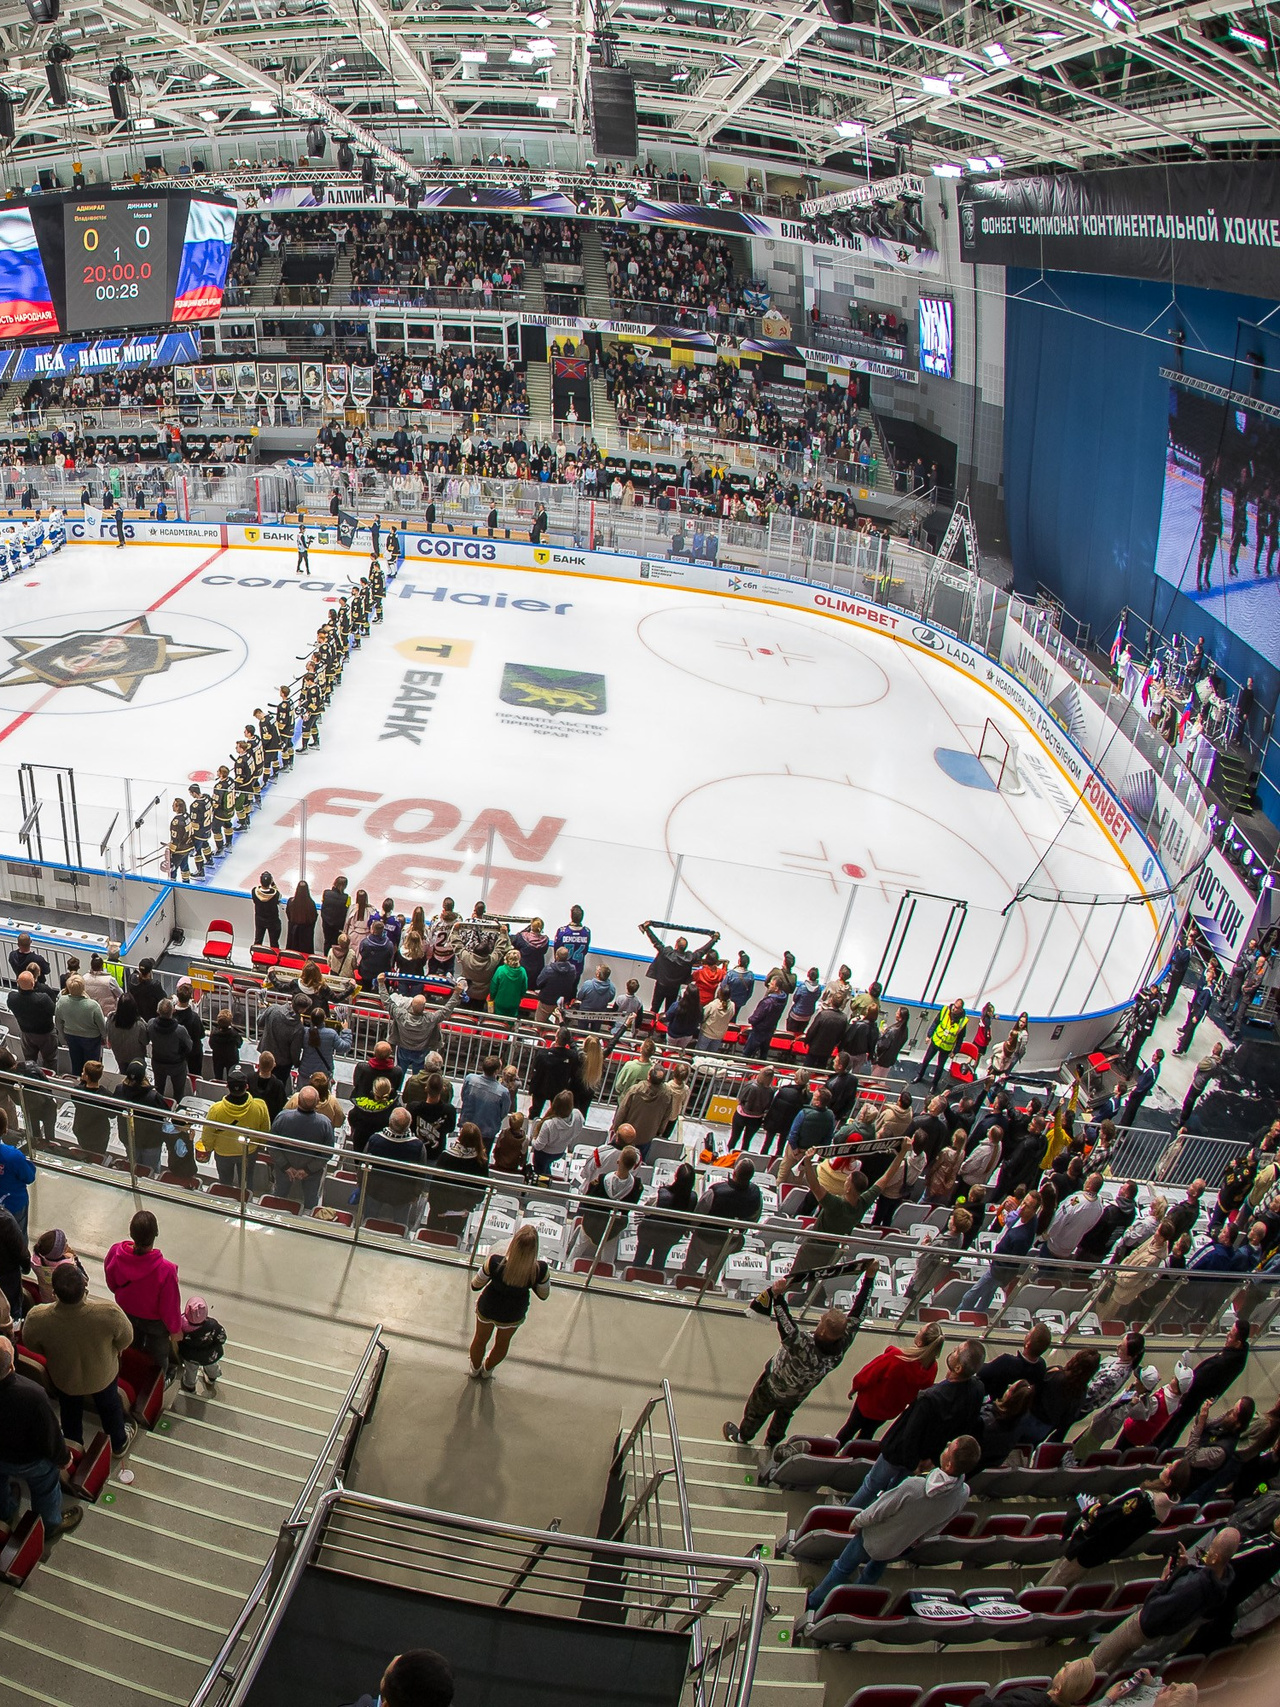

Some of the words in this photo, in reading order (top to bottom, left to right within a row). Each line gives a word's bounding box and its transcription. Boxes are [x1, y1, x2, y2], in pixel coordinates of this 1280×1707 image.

[76, 204, 106, 212] АДМИРАЛ
[135, 225, 150, 249] 0
[781, 222, 863, 252] ВЛАВОСТОК
[981, 214, 1017, 235] ФОНБЕТ
[1019, 213, 1080, 236] ЧЕМПИОНАТ
[1082, 208, 1220, 242] КОНТИНЕНТАЛЬНОЙ
[1223, 216, 1280, 248] ХОККЕ
[83, 228, 99, 252] 0
[113, 246, 121, 261] 1
[83, 262, 152, 284] 20:00.0
[95, 283, 139, 300] 00:28
[15, 311, 52, 323] НАРОДНАЯ!
[521, 313, 577, 328] ВЛАДИВОСТОК
[610, 321, 647, 336] АДМИРАЛ
[35, 350, 64, 372] ЛЁД
[80, 347, 119, 368] НАШЕ
[124, 343, 158, 363] МОРЕ
[804, 349, 840, 365] АДМИРАЛ
[867, 360, 916, 382] ВЛАДИВОСТОК
[71, 524, 136, 538] сгаз
[160, 527, 219, 538] HCADMIRAL.PRO
[263, 532, 294, 541] БАНК
[553, 554, 586, 565] БАНК
[399, 584, 573, 615] Haier
[814, 595, 899, 629] OLIMPBET
[946, 643, 976, 669] LADA
[377, 668, 444, 746] БАНК
[995, 675, 1037, 722] HCADMIRAL.PRO
[495, 712, 608, 731] ПРАВИТЕЛЬСТВО
[500, 719, 603, 736] ПРИМОРСКОГО
[533, 729, 569, 738] КРАЯ
[1040, 717, 1082, 781] Ростелеком
[1085, 774, 1133, 844] FONBET
[273, 787, 567, 863] FON
[239, 838, 563, 916] BET
[713, 1104, 733, 1115] 101
[732, 1259, 763, 1269] АДМИРАЛ
